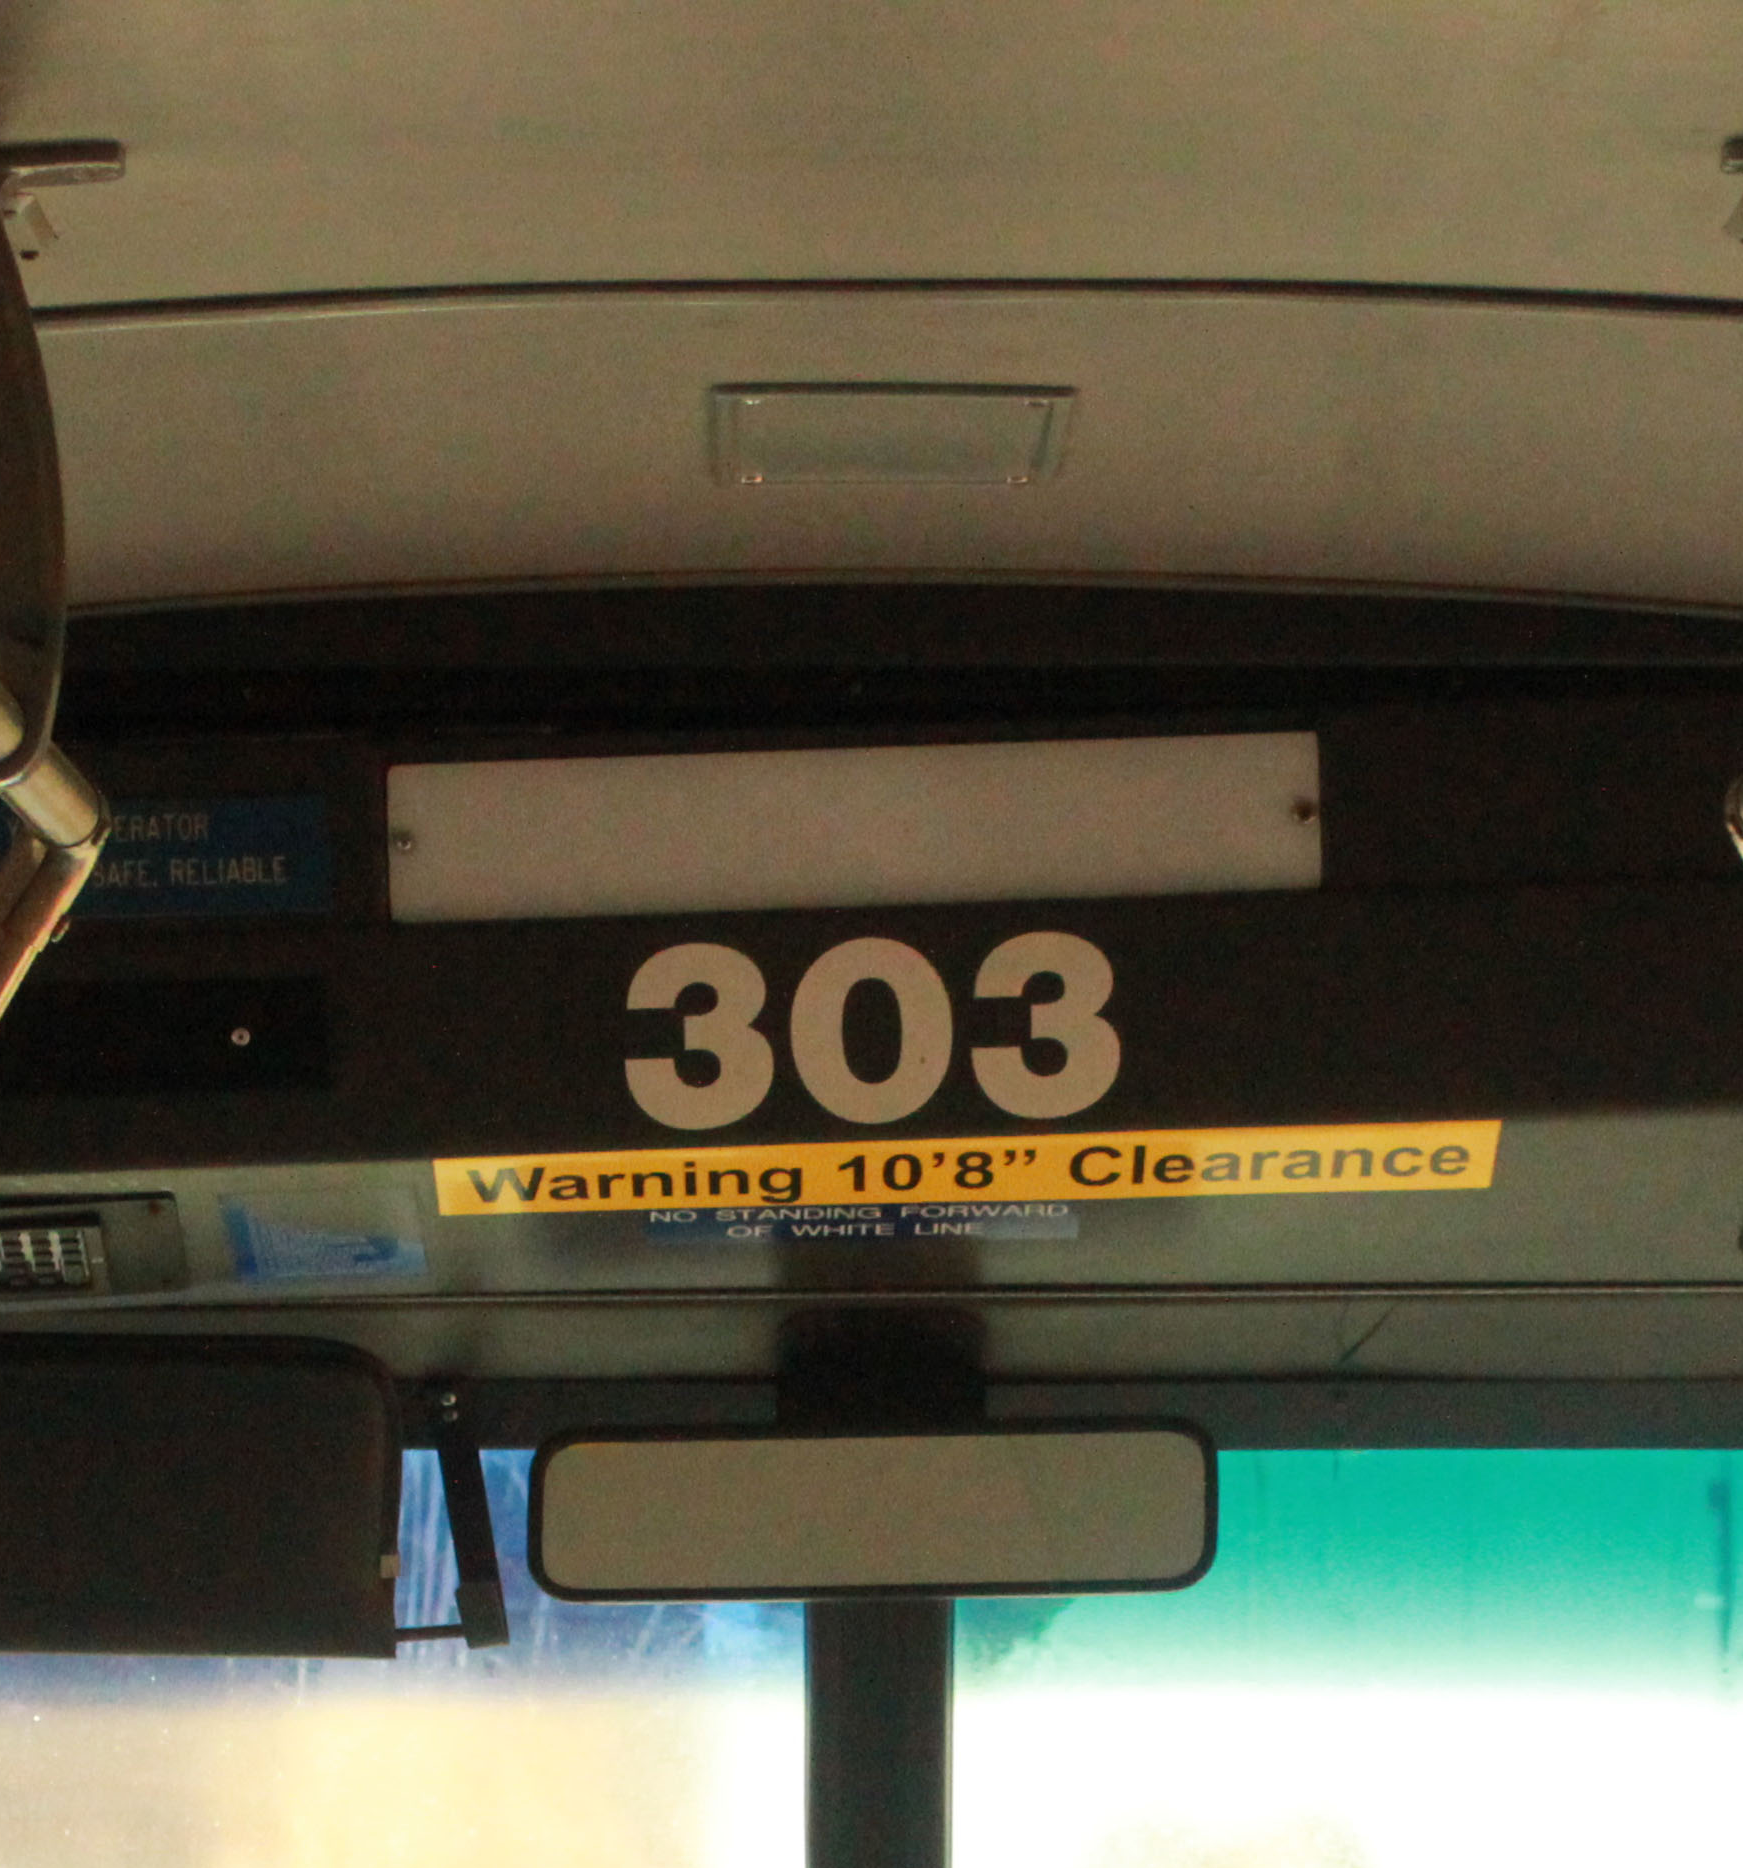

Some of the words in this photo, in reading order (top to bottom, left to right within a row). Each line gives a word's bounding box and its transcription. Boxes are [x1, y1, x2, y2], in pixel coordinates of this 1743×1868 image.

[114, 813, 210, 842] ERATOR
[169, 854, 290, 886] RELIABLE
[625, 931, 1121, 1130] 303
[466, 1160, 804, 1203] Warning
[1069, 1143, 1471, 1186] Clearance
[649, 1210, 698, 1223] NO
[714, 1206, 882, 1222] STANDING
[900, 1203, 1069, 1219] FORWARD
[726, 1224, 773, 1238] OF
[790, 1222, 895, 1237] WHITE
[914, 1221, 983, 1236] LINE
